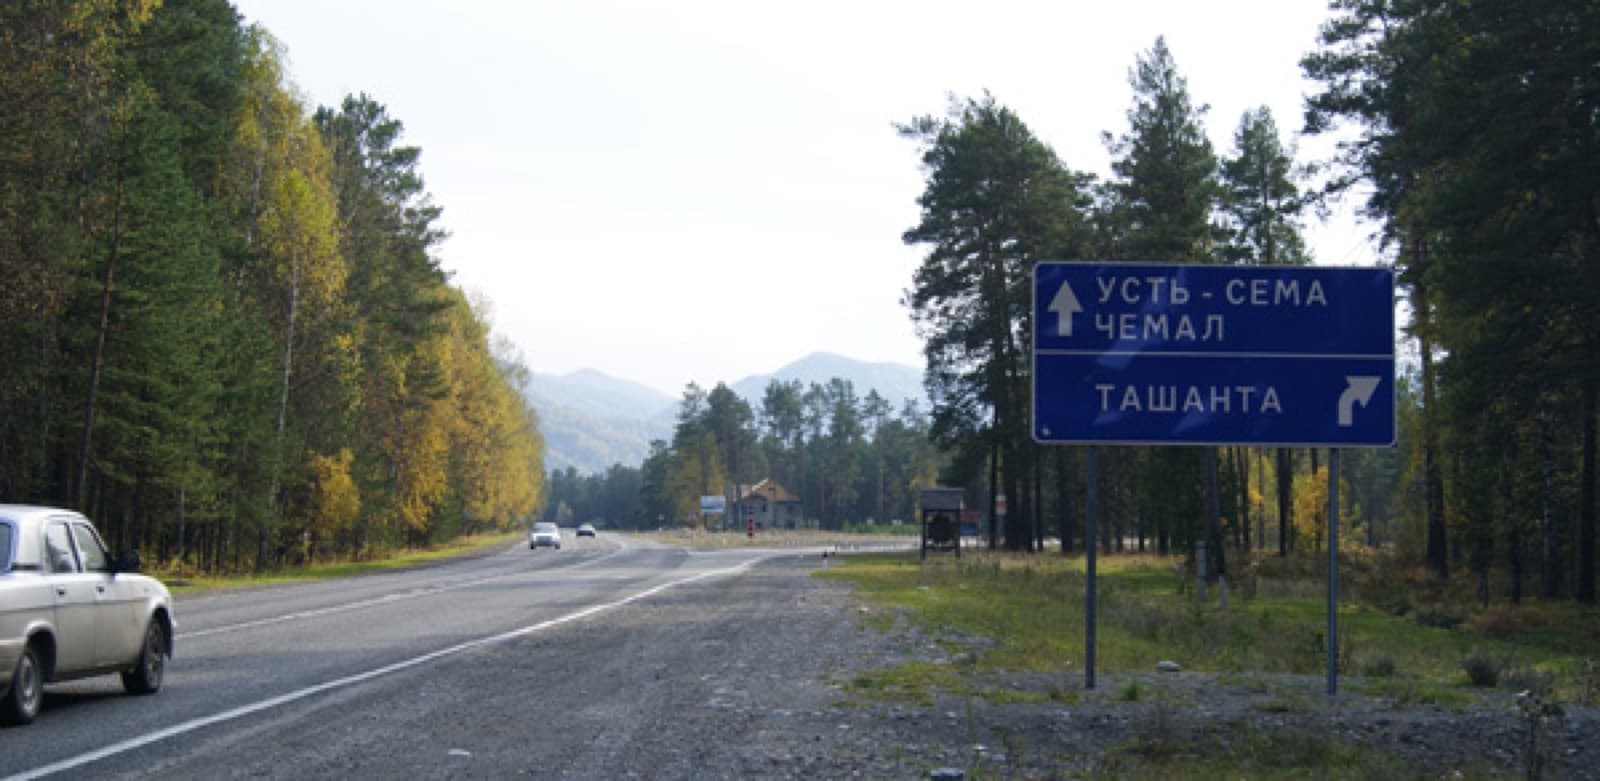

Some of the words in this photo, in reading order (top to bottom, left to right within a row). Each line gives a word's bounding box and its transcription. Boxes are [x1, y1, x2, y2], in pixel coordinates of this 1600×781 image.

[1097, 276, 1190, 304] УСТЬ
[1225, 279, 1327, 306] СЕМА
[1095, 314, 1225, 341] ЧЕМАЛ
[1095, 384, 1282, 413] ТАШАНТА
